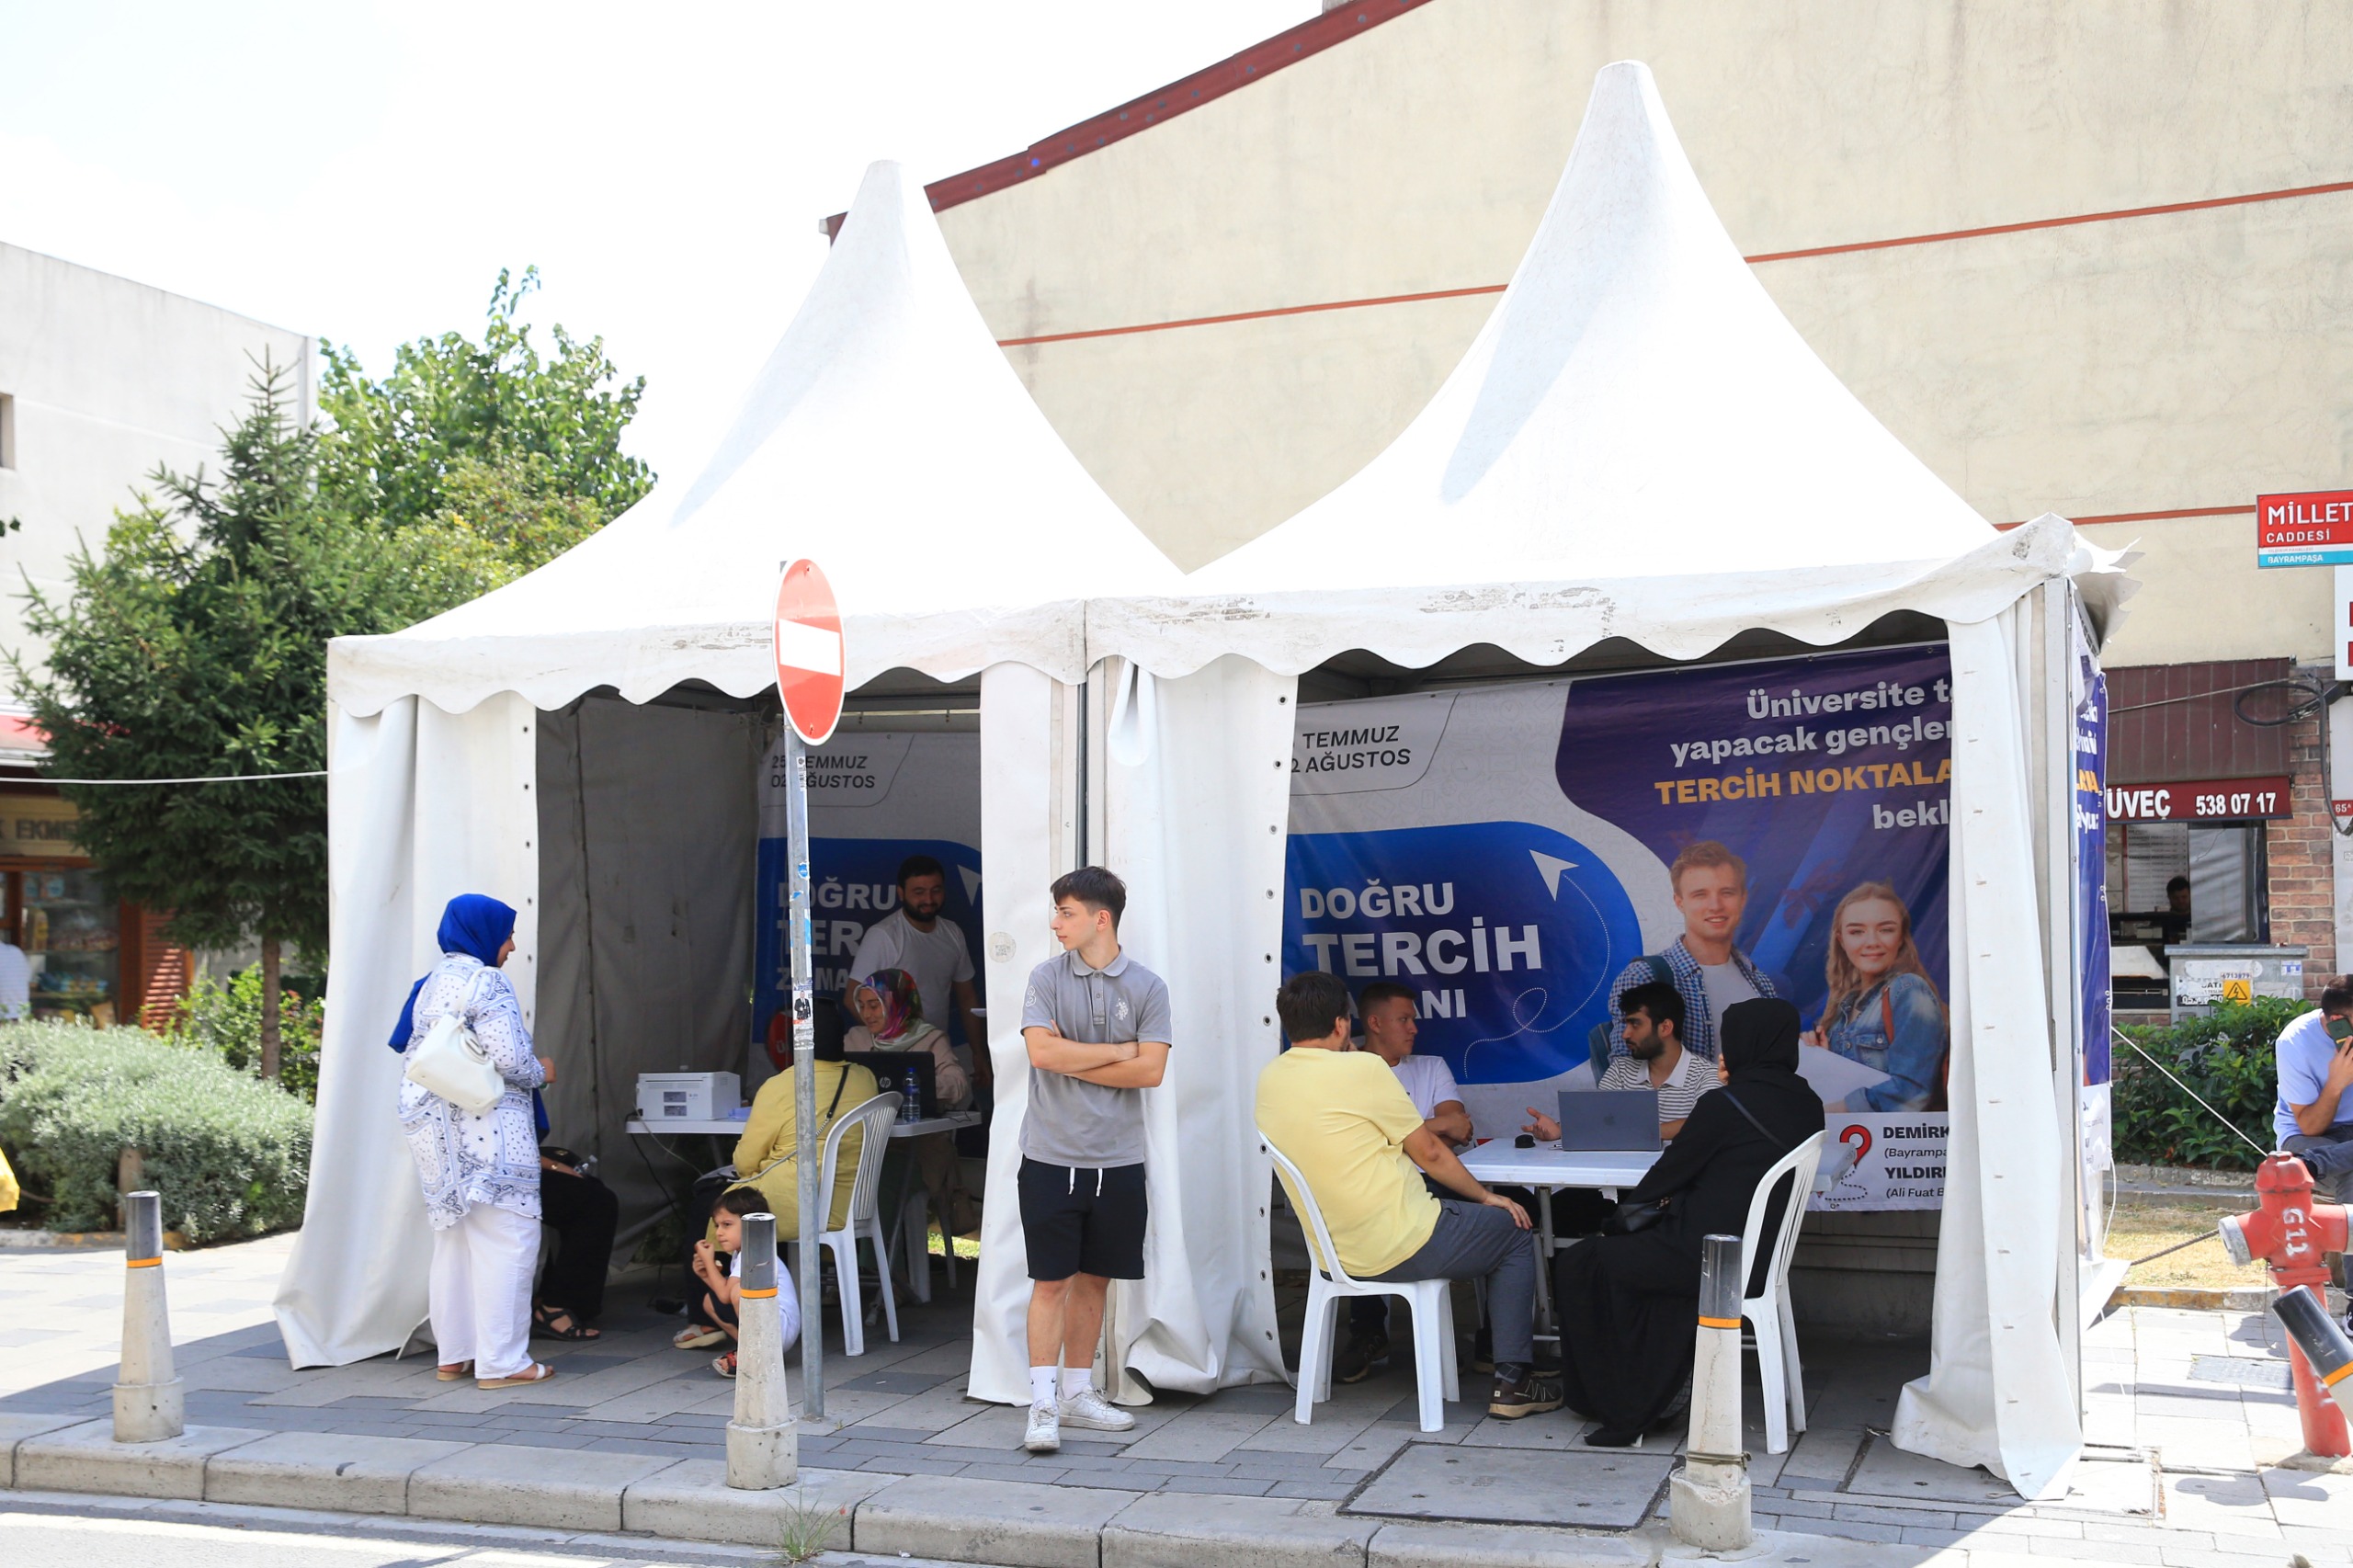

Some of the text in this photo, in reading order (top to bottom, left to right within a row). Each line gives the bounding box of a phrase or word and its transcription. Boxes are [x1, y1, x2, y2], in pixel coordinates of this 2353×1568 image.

[2266, 528, 2330, 543] CADDESİ
[2268, 554, 2324, 563] BAYRAMPAŞA
[1747, 681, 1925, 720] Üniversite
[1302, 725, 1400, 749] TEMMUZ
[1670, 726, 1817, 767] yapacak
[806, 756, 868, 769] EMMUZ
[1290, 748, 1412, 773] 2 AĞUSTOS
[806, 772, 875, 789] ĞUSTOS
[1654, 767, 1781, 805] TERCİH
[2196, 794, 2226, 815] 538
[2231, 793, 2251, 814] 07
[2256, 792, 2277, 813] 17
[1300, 878, 1454, 919] DOĞRU
[1302, 916, 1542, 977] TERCİH
[1025, 985, 1037, 1007] 3
[1886, 1187, 1905, 1199] (Ali
[1907, 1188, 1934, 1197] Fuat
